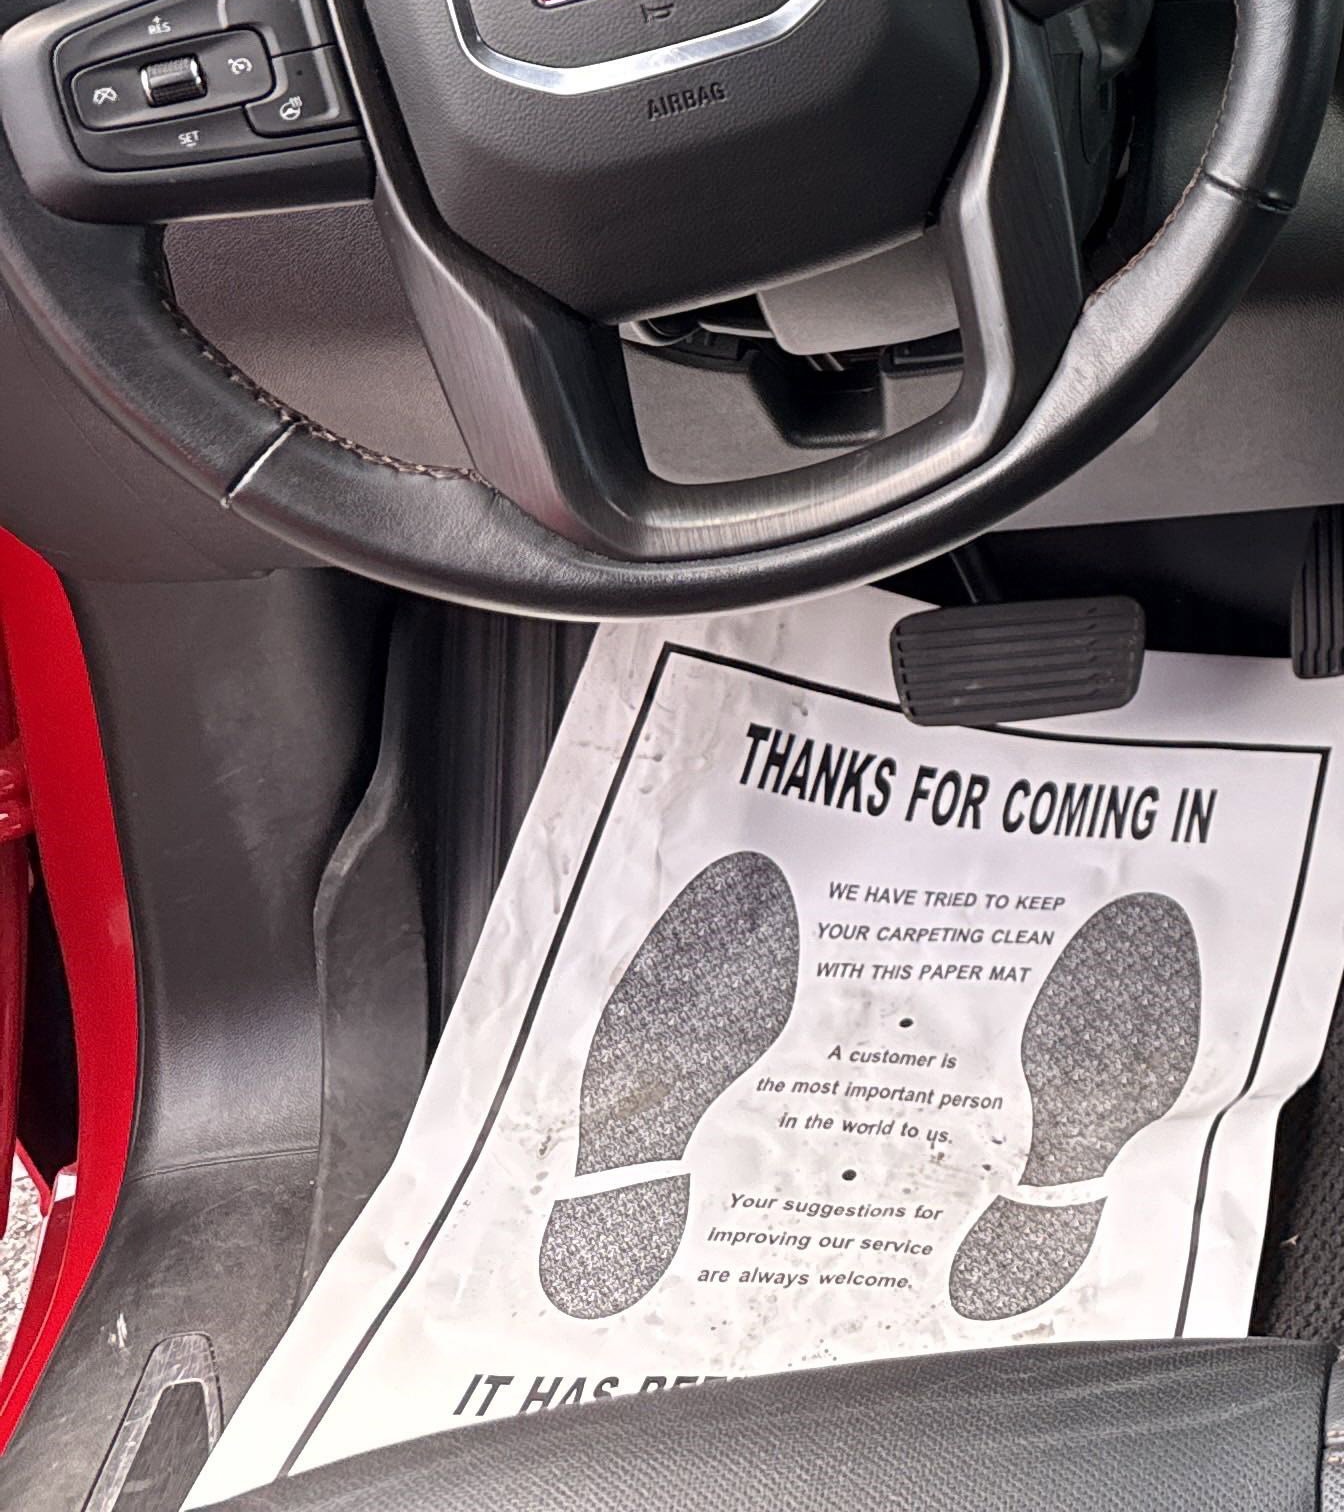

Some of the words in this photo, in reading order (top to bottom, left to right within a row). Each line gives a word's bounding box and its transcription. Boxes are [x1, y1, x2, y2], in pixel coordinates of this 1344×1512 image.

[647, 82, 726, 121] AIRBAG
[178, 129, 200, 145] SET
[739, 722, 897, 817] THANKS
[905, 765, 992, 830] FOR
[1001, 778, 1161, 842] COMING
[1171, 787, 1218, 844] IN
[828, 881, 860, 902] WE
[864, 885, 916, 907] HAVE
[923, 890, 978, 908] TRIED
[984, 893, 1010, 910] TO
[1015, 895, 1066, 911] KEEP
[817, 922, 870, 941] YOUR
[876, 926, 985, 944] CARPETING
[991, 929, 1055, 945] CLEAN
[816, 961, 865, 980] WITH
[871, 964, 913, 981] THIS
[918, 964, 982, 981] PAPER
[988, 965, 1032, 984] MAT
[827, 1044, 842, 1061] A
[849, 1048, 937, 1068] customer
[940, 1052, 958, 1070] is
[756, 1076, 785, 1093] the
[791, 1080, 840, 1096] most
[844, 1082, 934, 1106] important
[938, 1092, 1004, 1111] person
[778, 1111, 798, 1129] in
[804, 1113, 834, 1131] the
[842, 1118, 896, 1137] world
[900, 1121, 919, 1138] to
[925, 1128, 953, 1146] us.
[729, 1193, 778, 1210] Your
[783, 1198, 907, 1219] suggestions
[914, 1204, 944, 1221] for
[707, 1227, 812, 1251] improving
[819, 1235, 855, 1250] our
[860, 1236, 934, 1257] service
[697, 1268, 731, 1284] are
[738, 1267, 810, 1289] always
[818, 1271, 914, 1290] welcome.
[453, 1373, 514, 1417] IT
[517, 1375, 620, 1416] HAS
